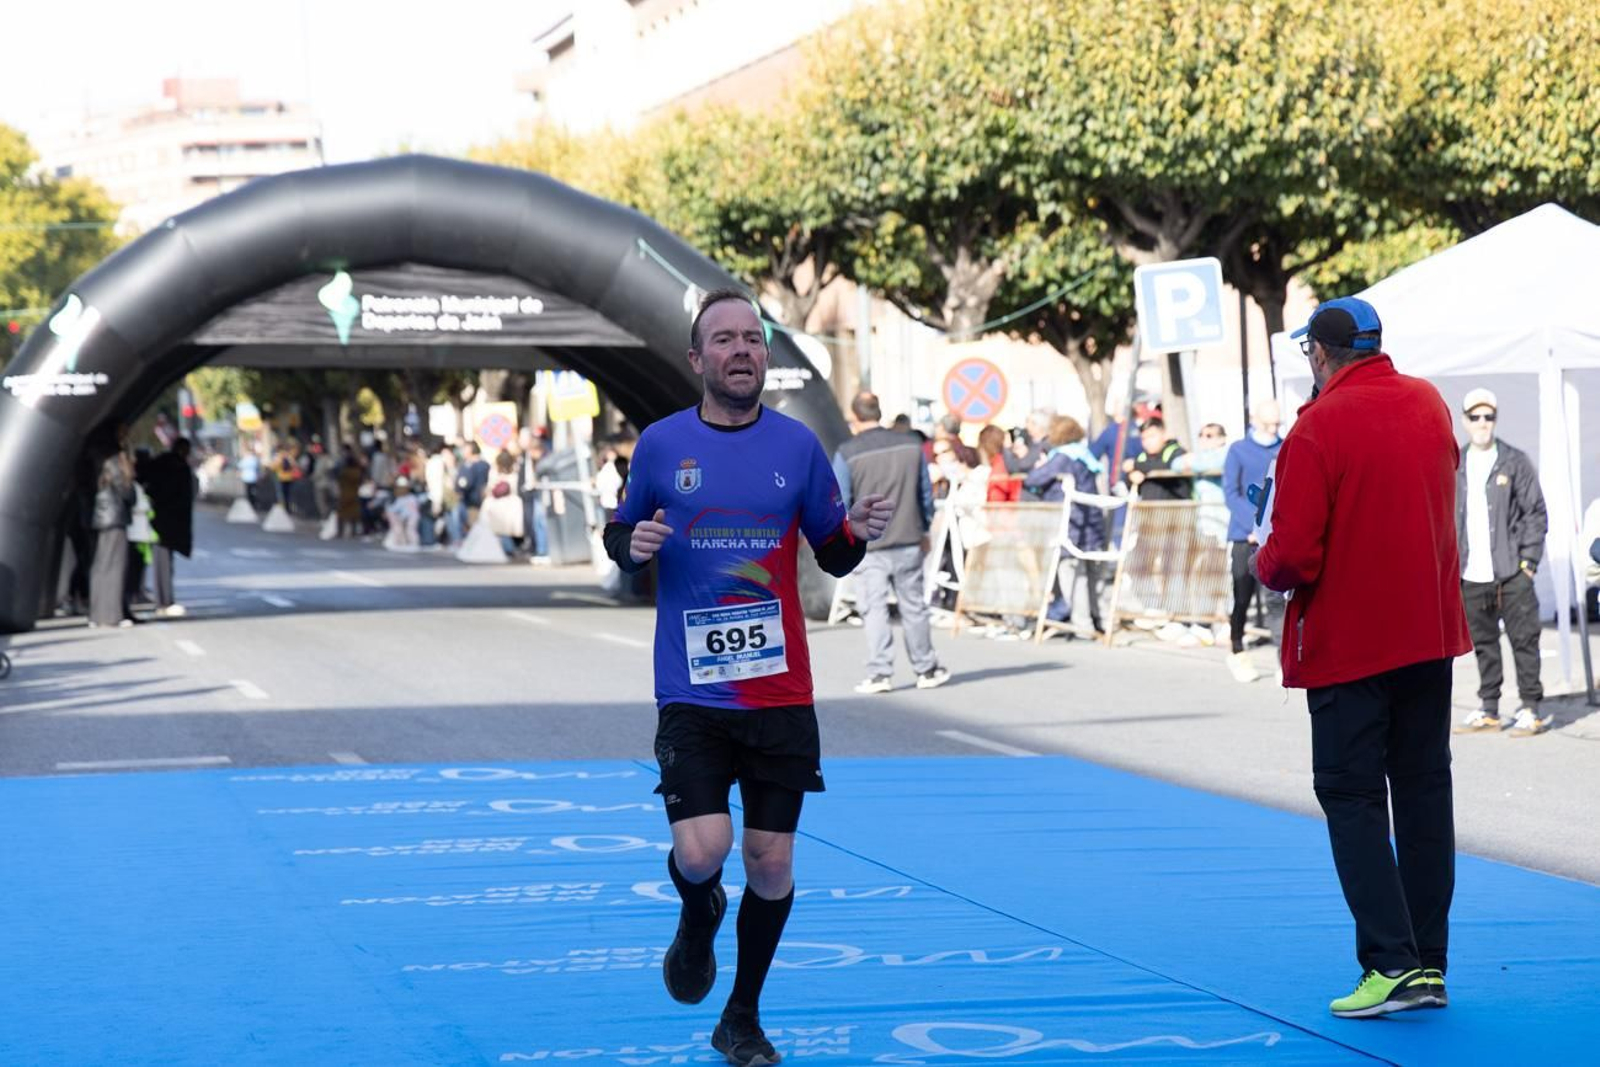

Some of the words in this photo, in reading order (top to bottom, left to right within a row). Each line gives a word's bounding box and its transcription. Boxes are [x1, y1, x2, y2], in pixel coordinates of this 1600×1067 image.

[441, 295, 518, 315] Municipal
[520, 295, 544, 314] de
[1153, 271, 1207, 342] P
[362, 312, 436, 333] Deportes
[436, 313, 460, 330] de
[691, 539, 749, 549] MANCHA
[751, 539, 783, 549] REAL
[706, 624, 767, 654] 695
[617, 1047, 851, 1065] MDIA
